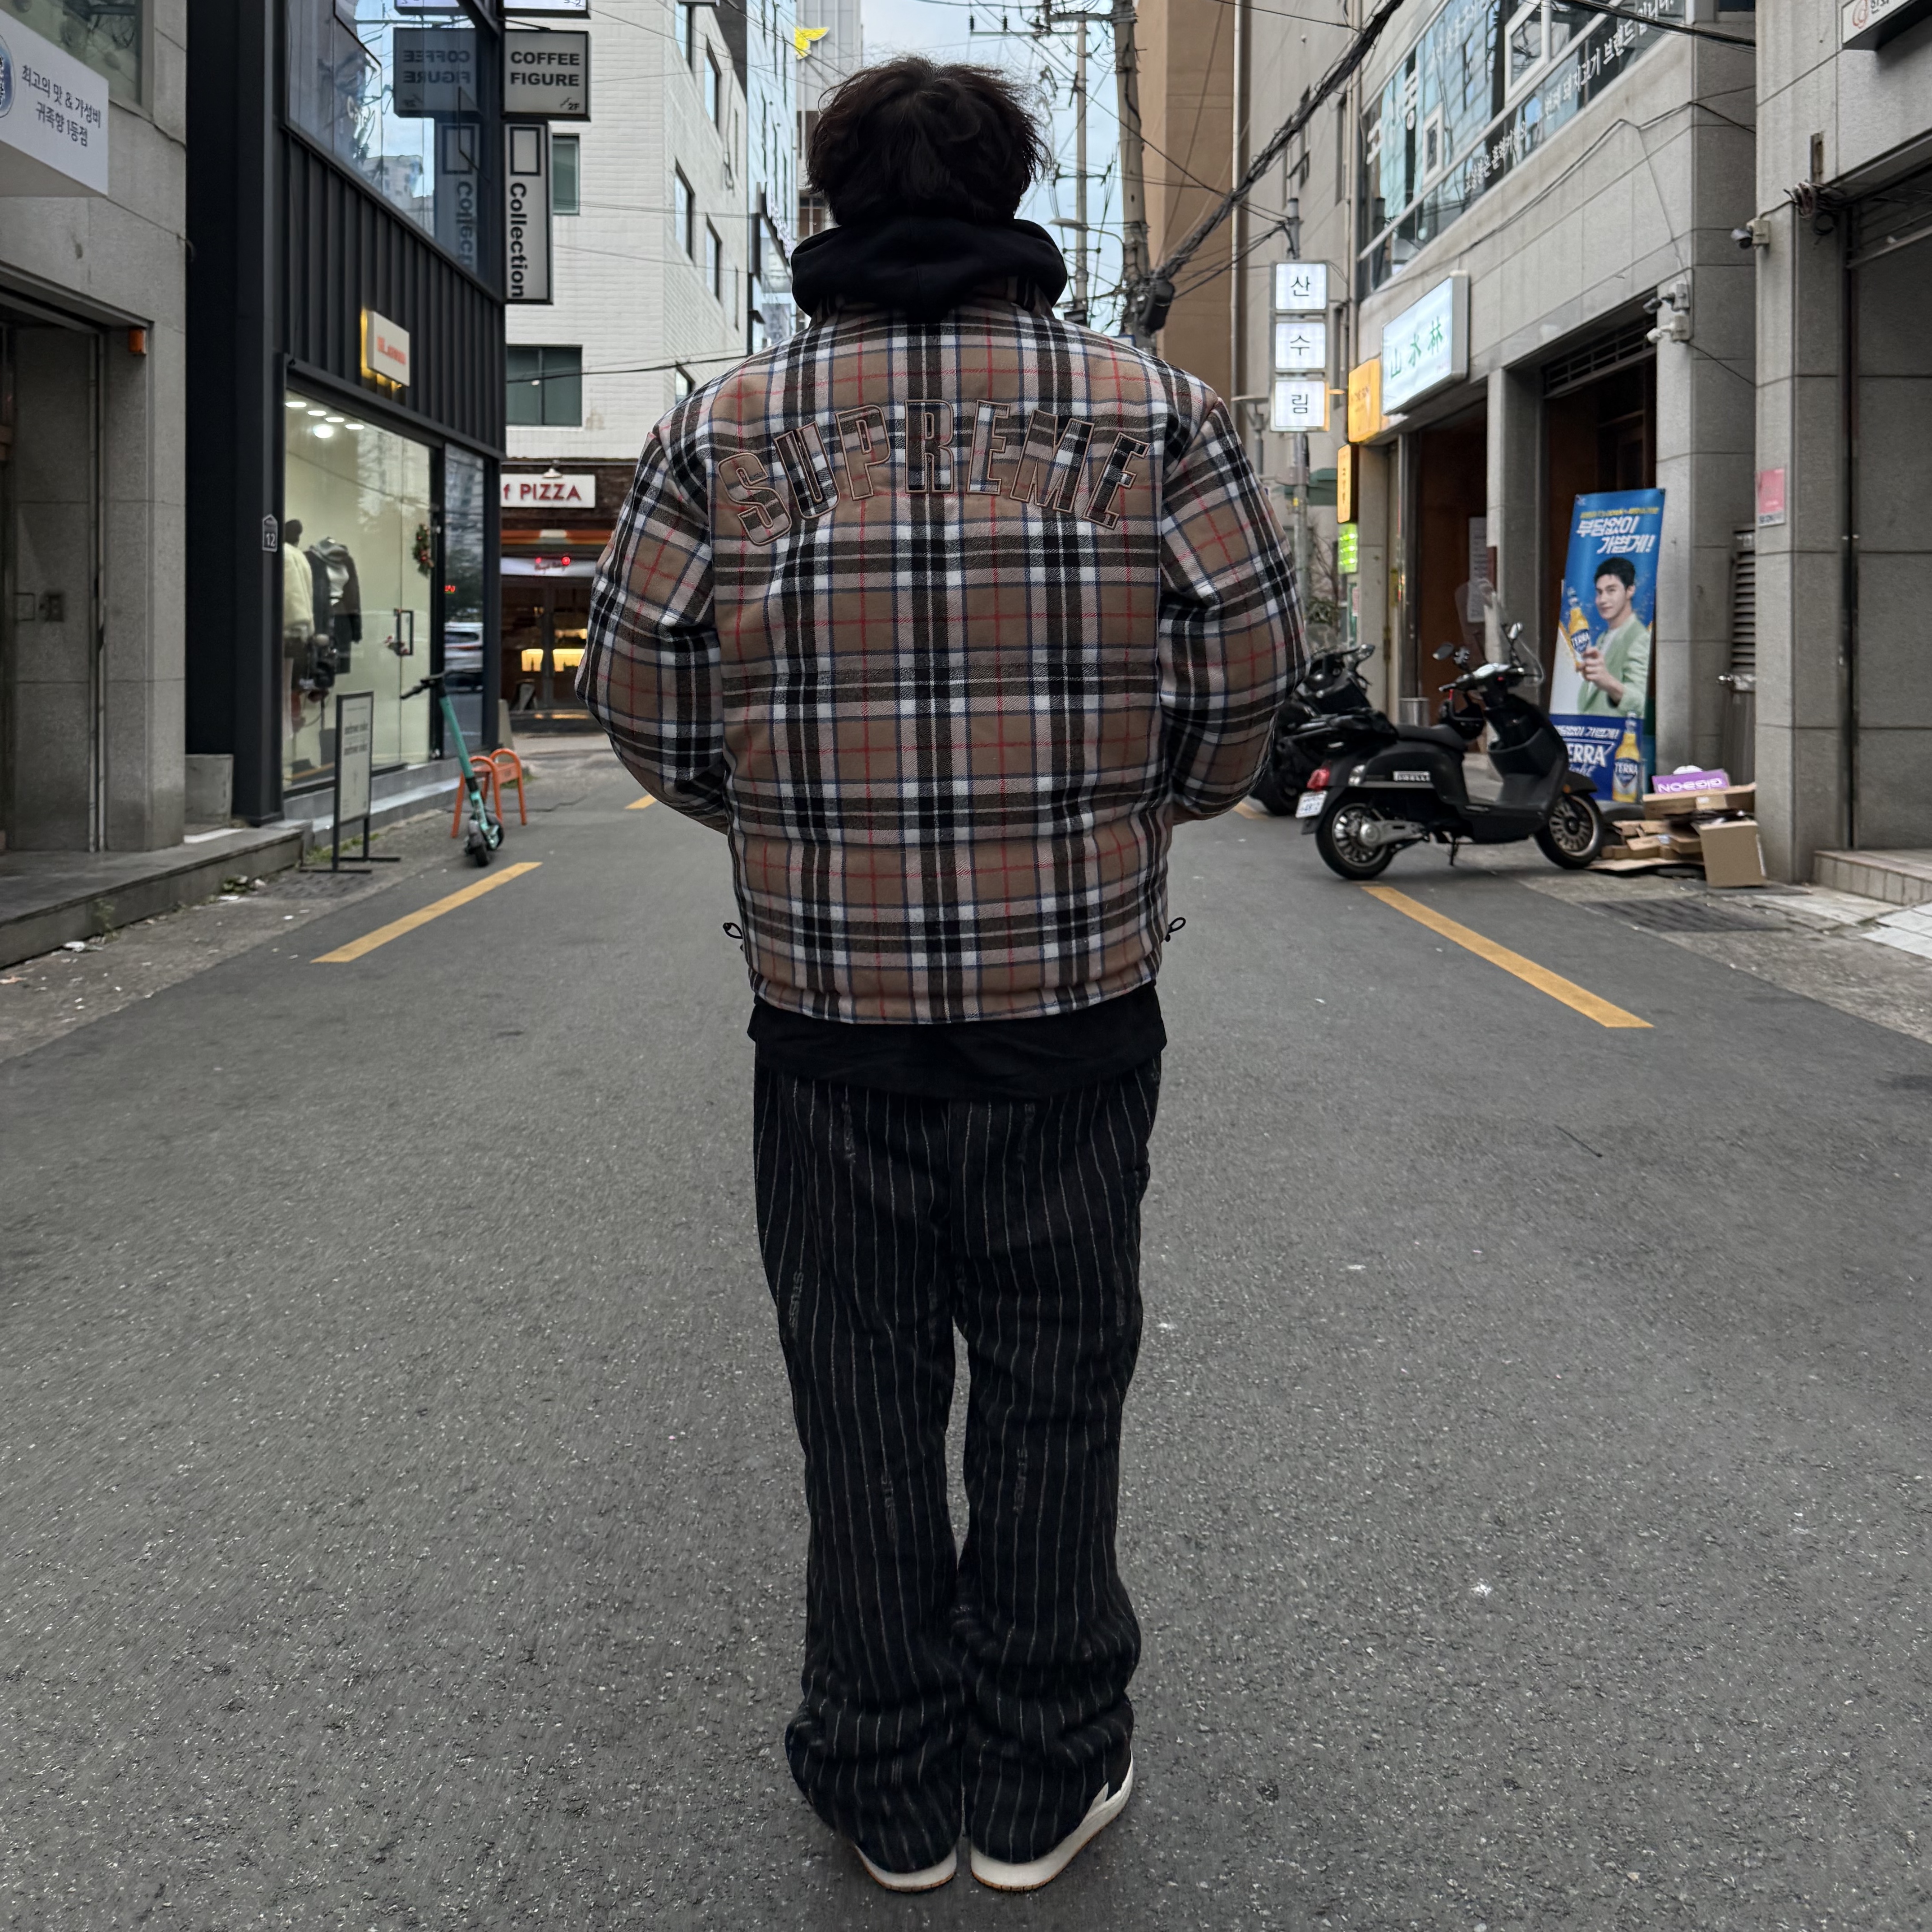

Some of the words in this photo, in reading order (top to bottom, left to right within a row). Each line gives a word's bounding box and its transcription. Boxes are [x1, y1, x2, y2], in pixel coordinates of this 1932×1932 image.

[1603, 18, 1637, 65] 브랜드
[511, 51, 580, 65] COFFEE
[510, 73, 580, 87] FIGURE
[22, 65, 51, 98] 최고의
[53, 84, 62, 105] 맛
[65, 92, 73, 110] &
[75, 97, 101, 128] 가성비
[568, 102, 580, 110] 2F
[510, 183, 527, 298] Collection
[718, 399, 1150, 547] SUPREME
[520, 483, 582, 501] PIZZA
[1576, 515, 1640, 538] 부담없이
[266, 533, 276, 547] 12
[1596, 534, 1656, 554] 가볍게!
[1566, 744, 1608, 768] ERRA
